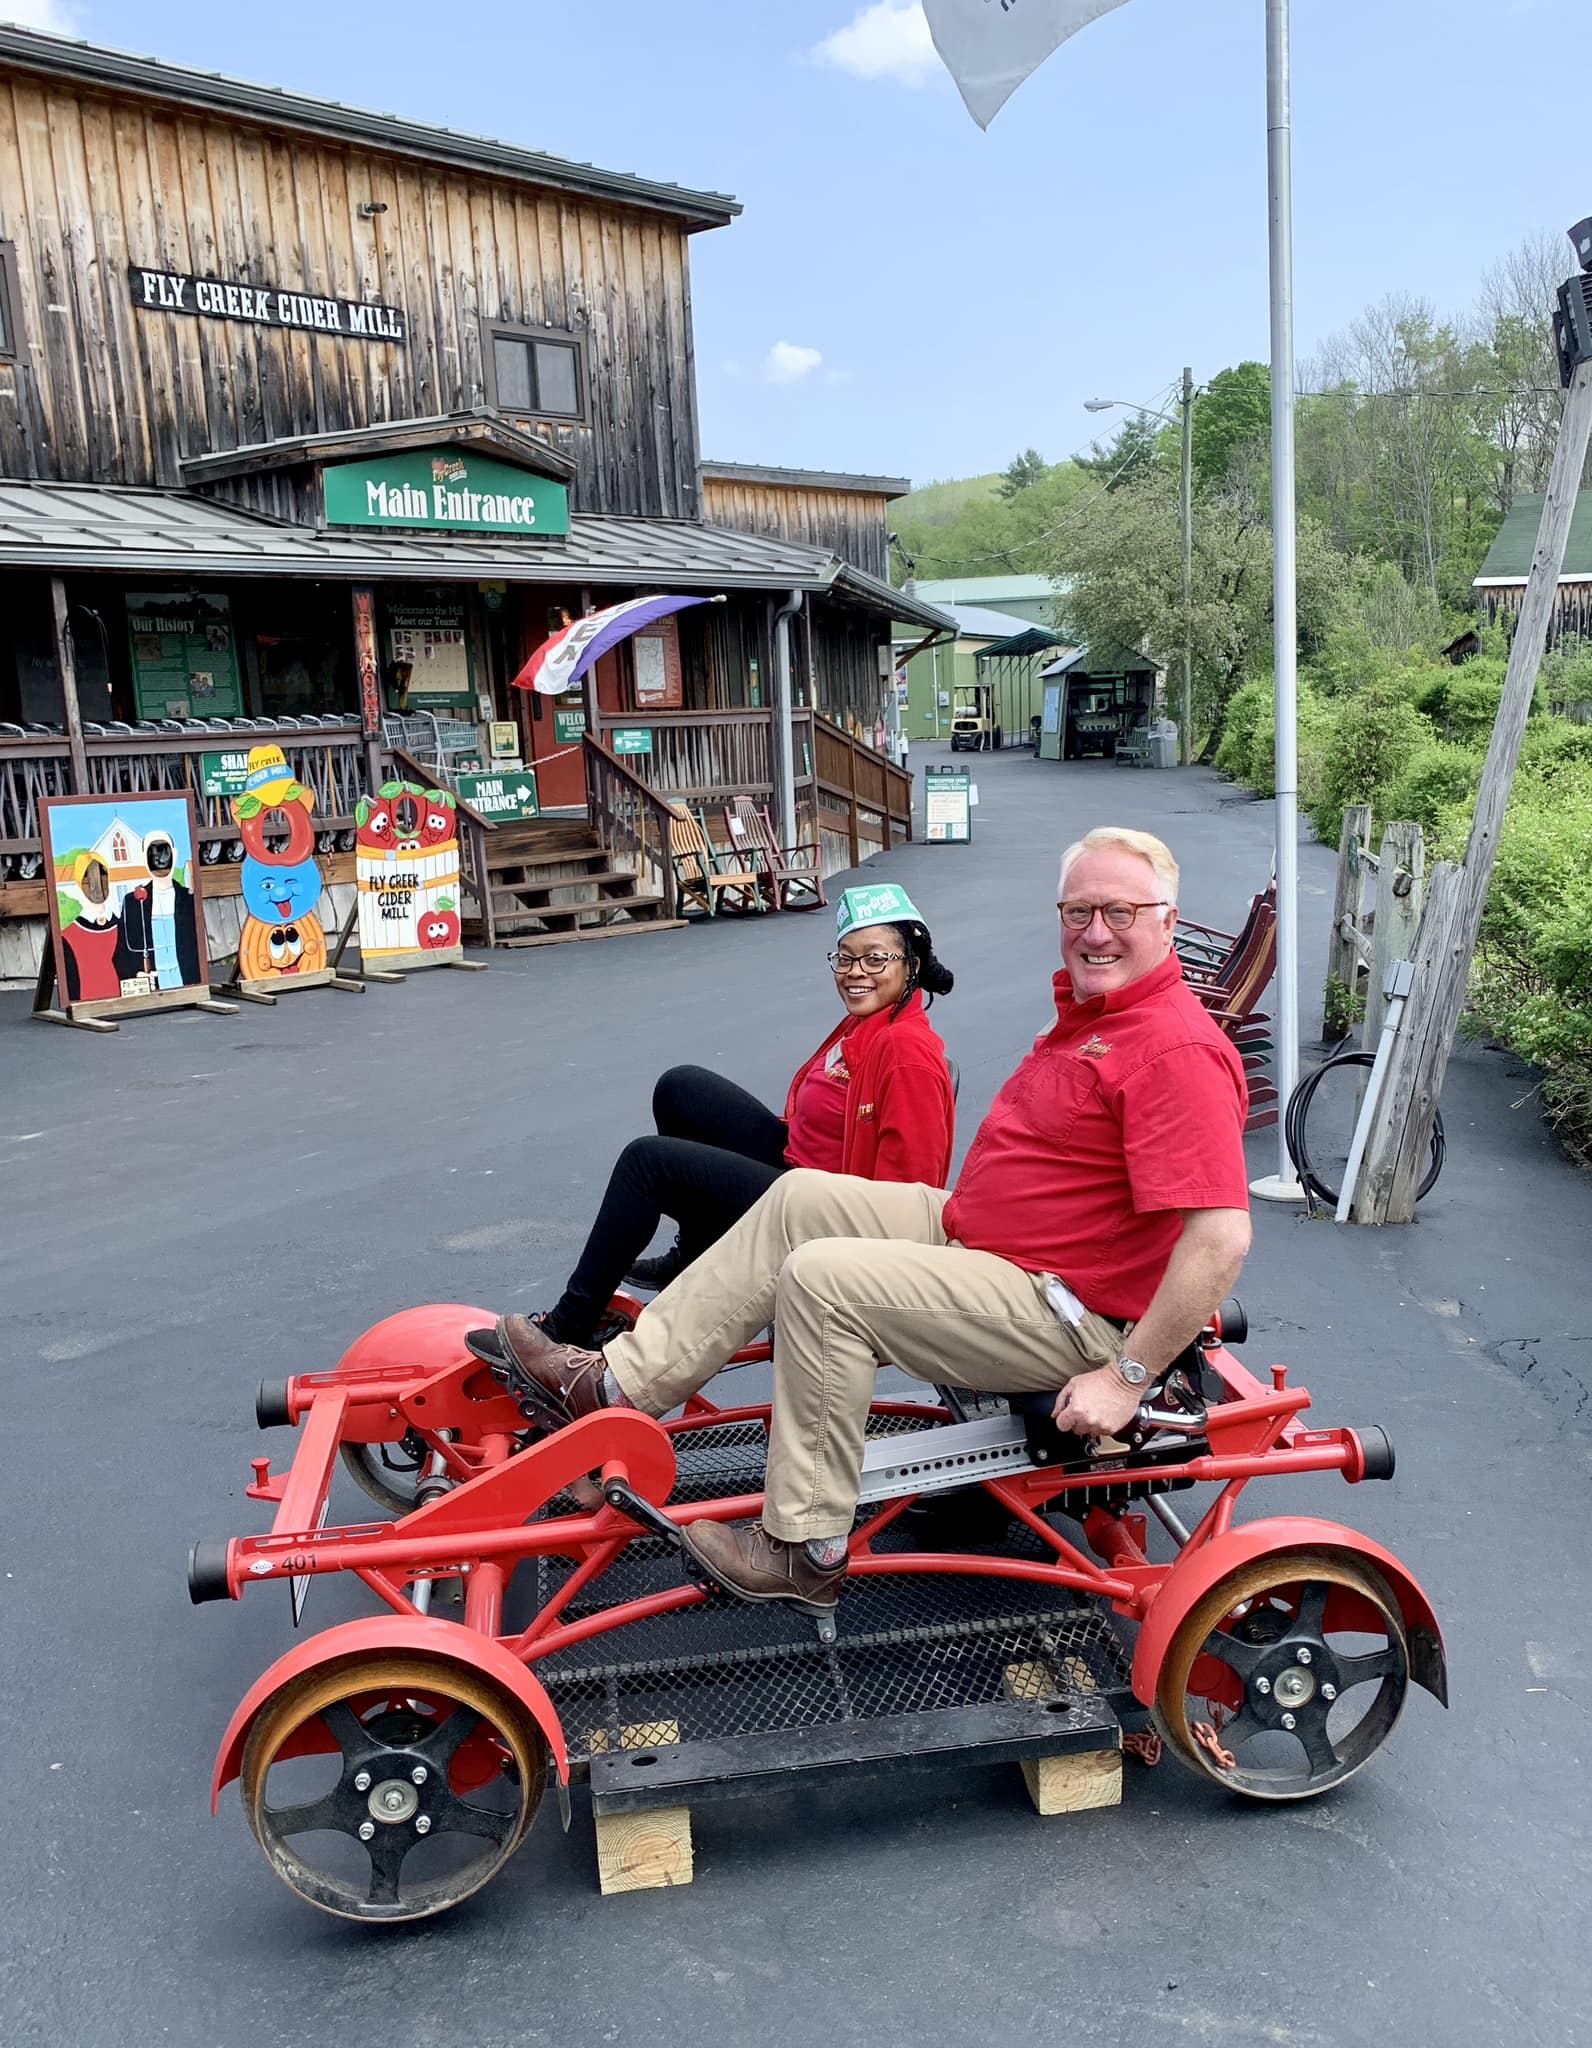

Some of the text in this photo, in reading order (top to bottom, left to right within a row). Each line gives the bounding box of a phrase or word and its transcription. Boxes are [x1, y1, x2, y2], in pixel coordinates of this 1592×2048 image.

[141, 272, 402, 338] FLY CREEK CIDER MILL
[365, 480, 536, 525] Main Entrance
[386, 604, 465, 616] Welcome to the Mill
[132, 616, 195, 634] Our History
[394, 617, 417, 626] Meet
[417, 618, 433, 626] our
[558, 712, 585, 726] WELCO
[221, 754, 248, 770] SHA
[249, 756, 281, 771] FLY CREEK
[476, 779, 504, 798] MAIN
[369, 873, 420, 891] FLY CREEK
[378, 890, 412, 907] CIDER
[382, 907, 409, 920] MILL
[281, 1553, 317, 1571] 401
